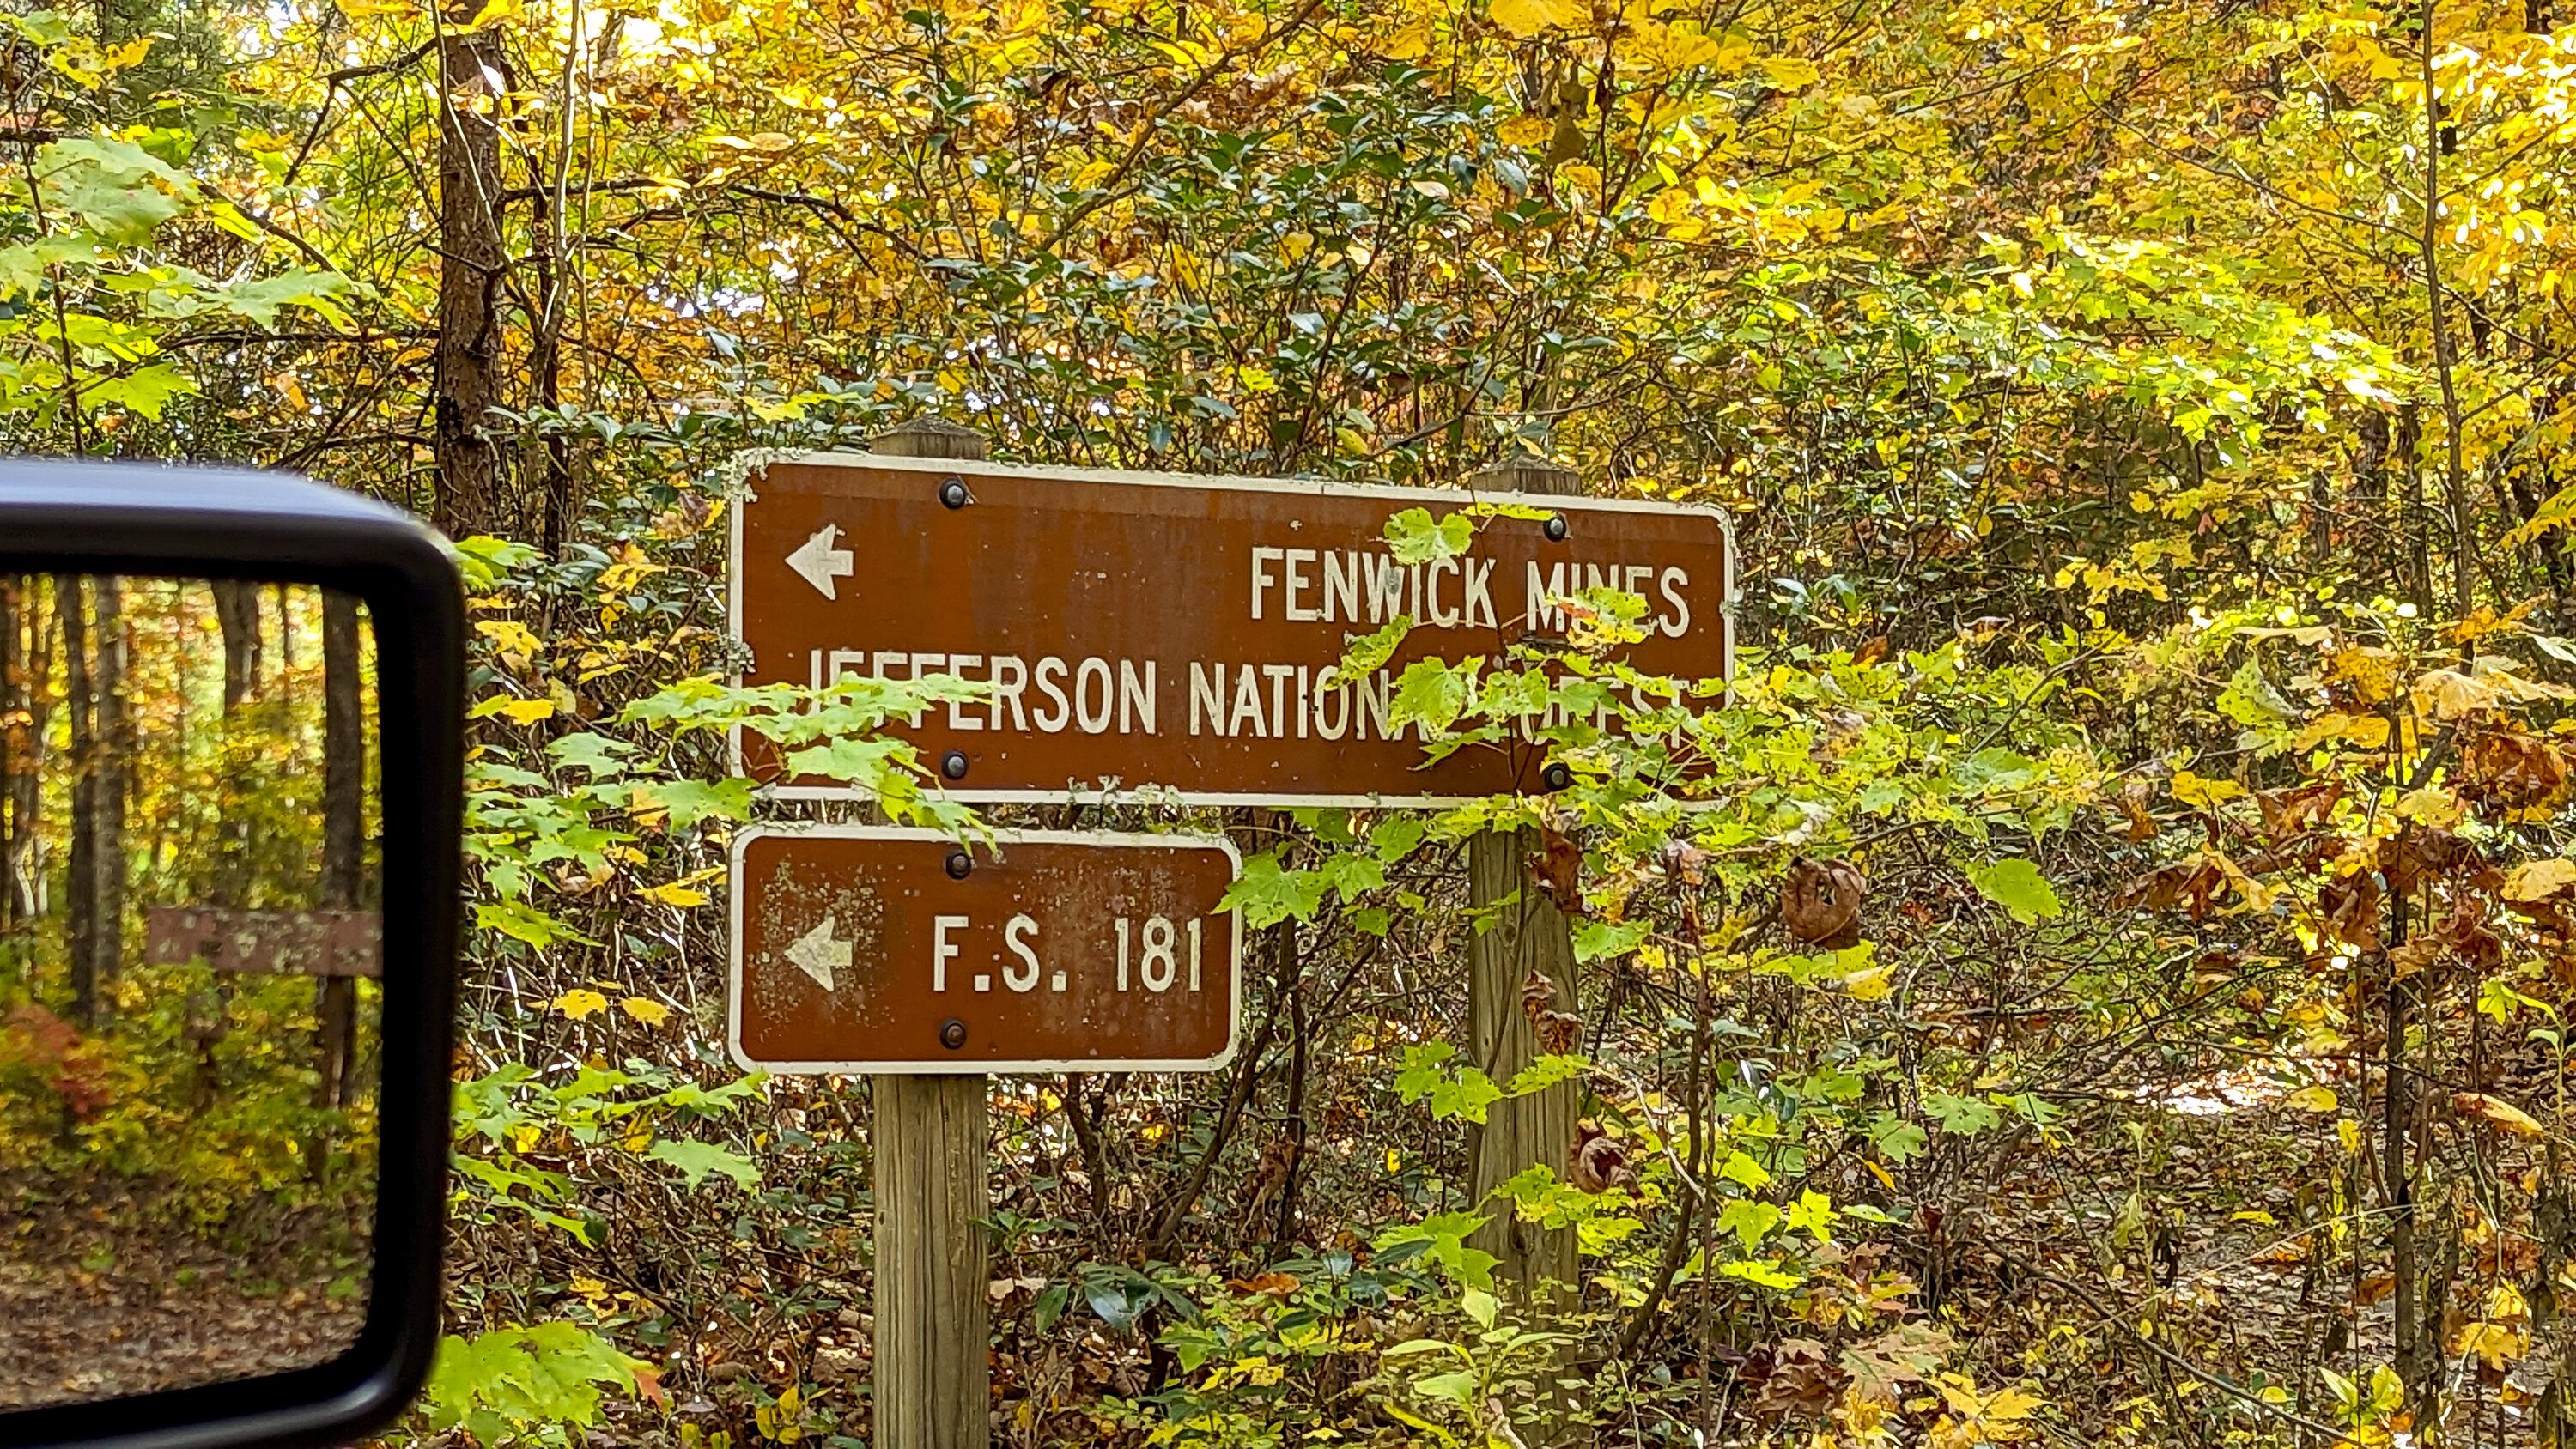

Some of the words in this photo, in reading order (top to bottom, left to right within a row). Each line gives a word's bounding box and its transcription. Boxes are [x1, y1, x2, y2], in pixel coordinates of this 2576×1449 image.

[1250, 546, 1498, 629] FENWICK
[1189, 660, 1463, 745] NATION
[933, 913, 1067, 994] F.S.
[1114, 913, 1202, 994] 181
